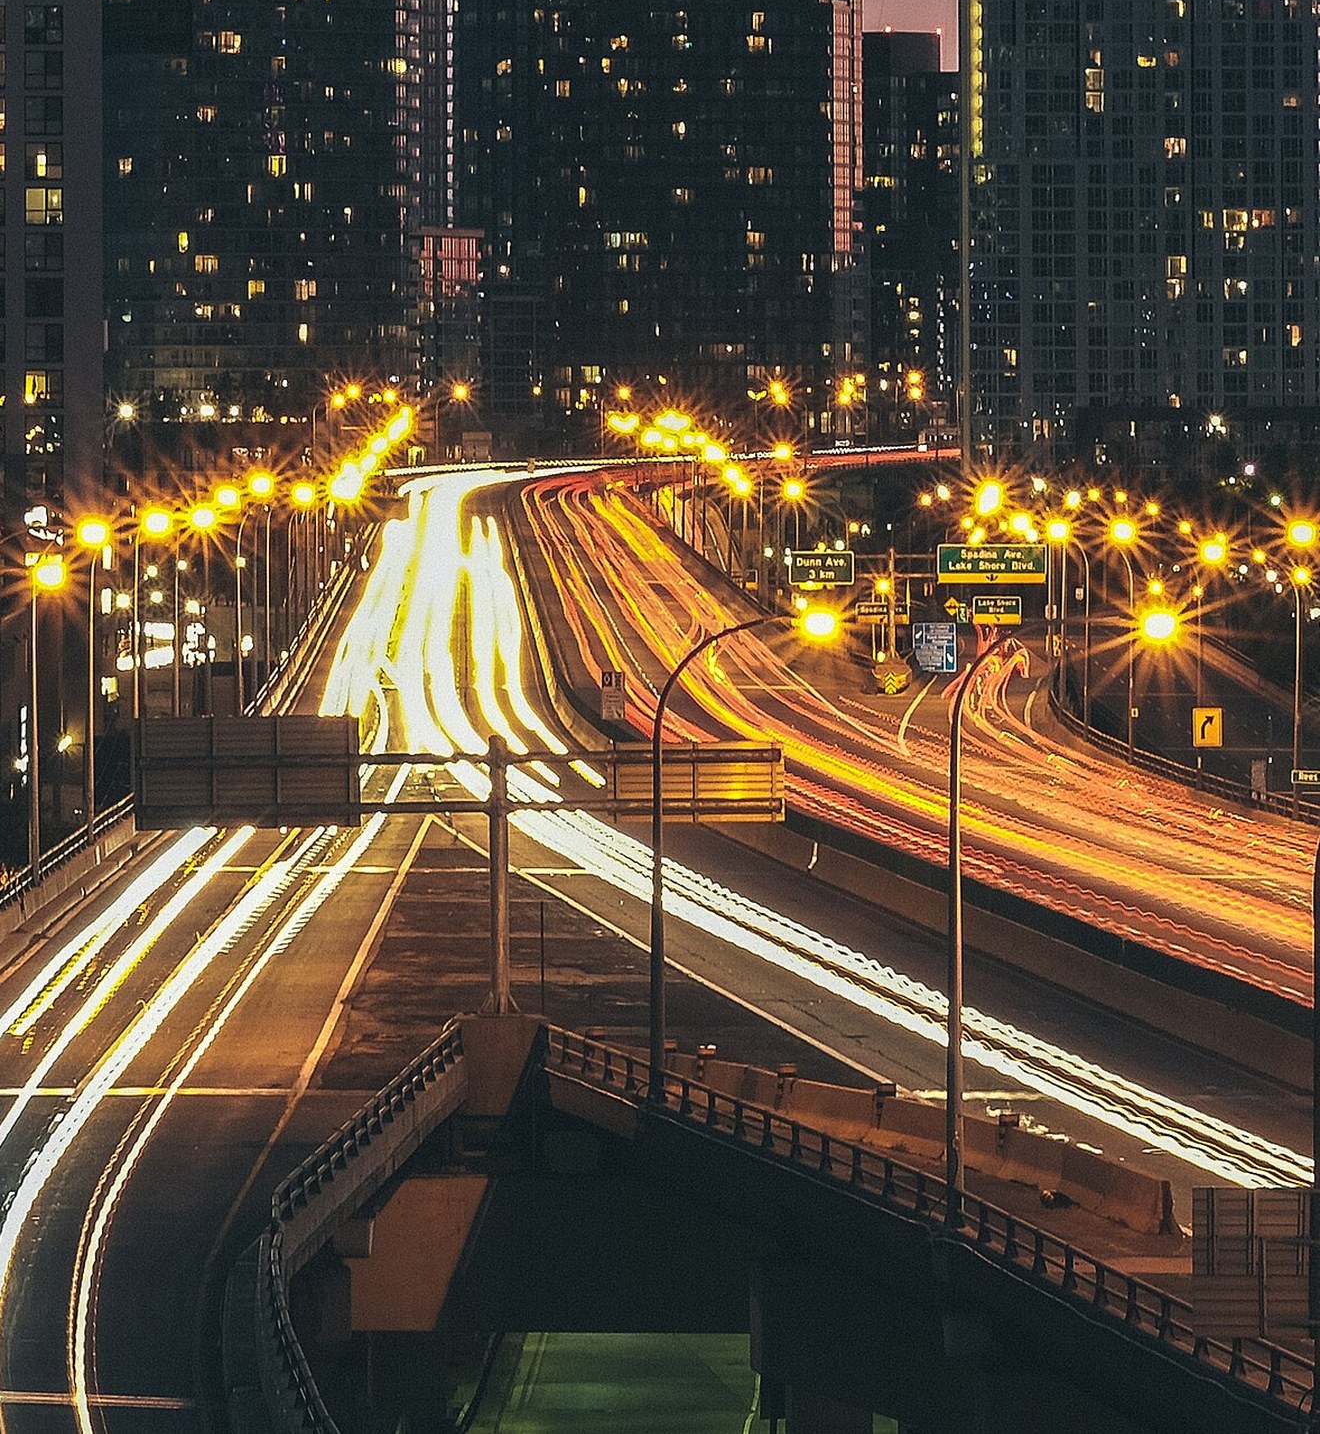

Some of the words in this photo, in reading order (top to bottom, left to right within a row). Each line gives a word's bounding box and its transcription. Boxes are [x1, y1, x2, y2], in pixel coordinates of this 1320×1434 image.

[960, 549, 998, 559] Spadina
[1004, 549, 1025, 559] Ave.
[796, 557, 822, 567] Dunn
[825, 556, 847, 567] Ave.
[948, 561, 972, 570] Lake
[979, 561, 1006, 570] Shore
[808, 569, 816, 579] 3
[819, 569, 835, 579] km
